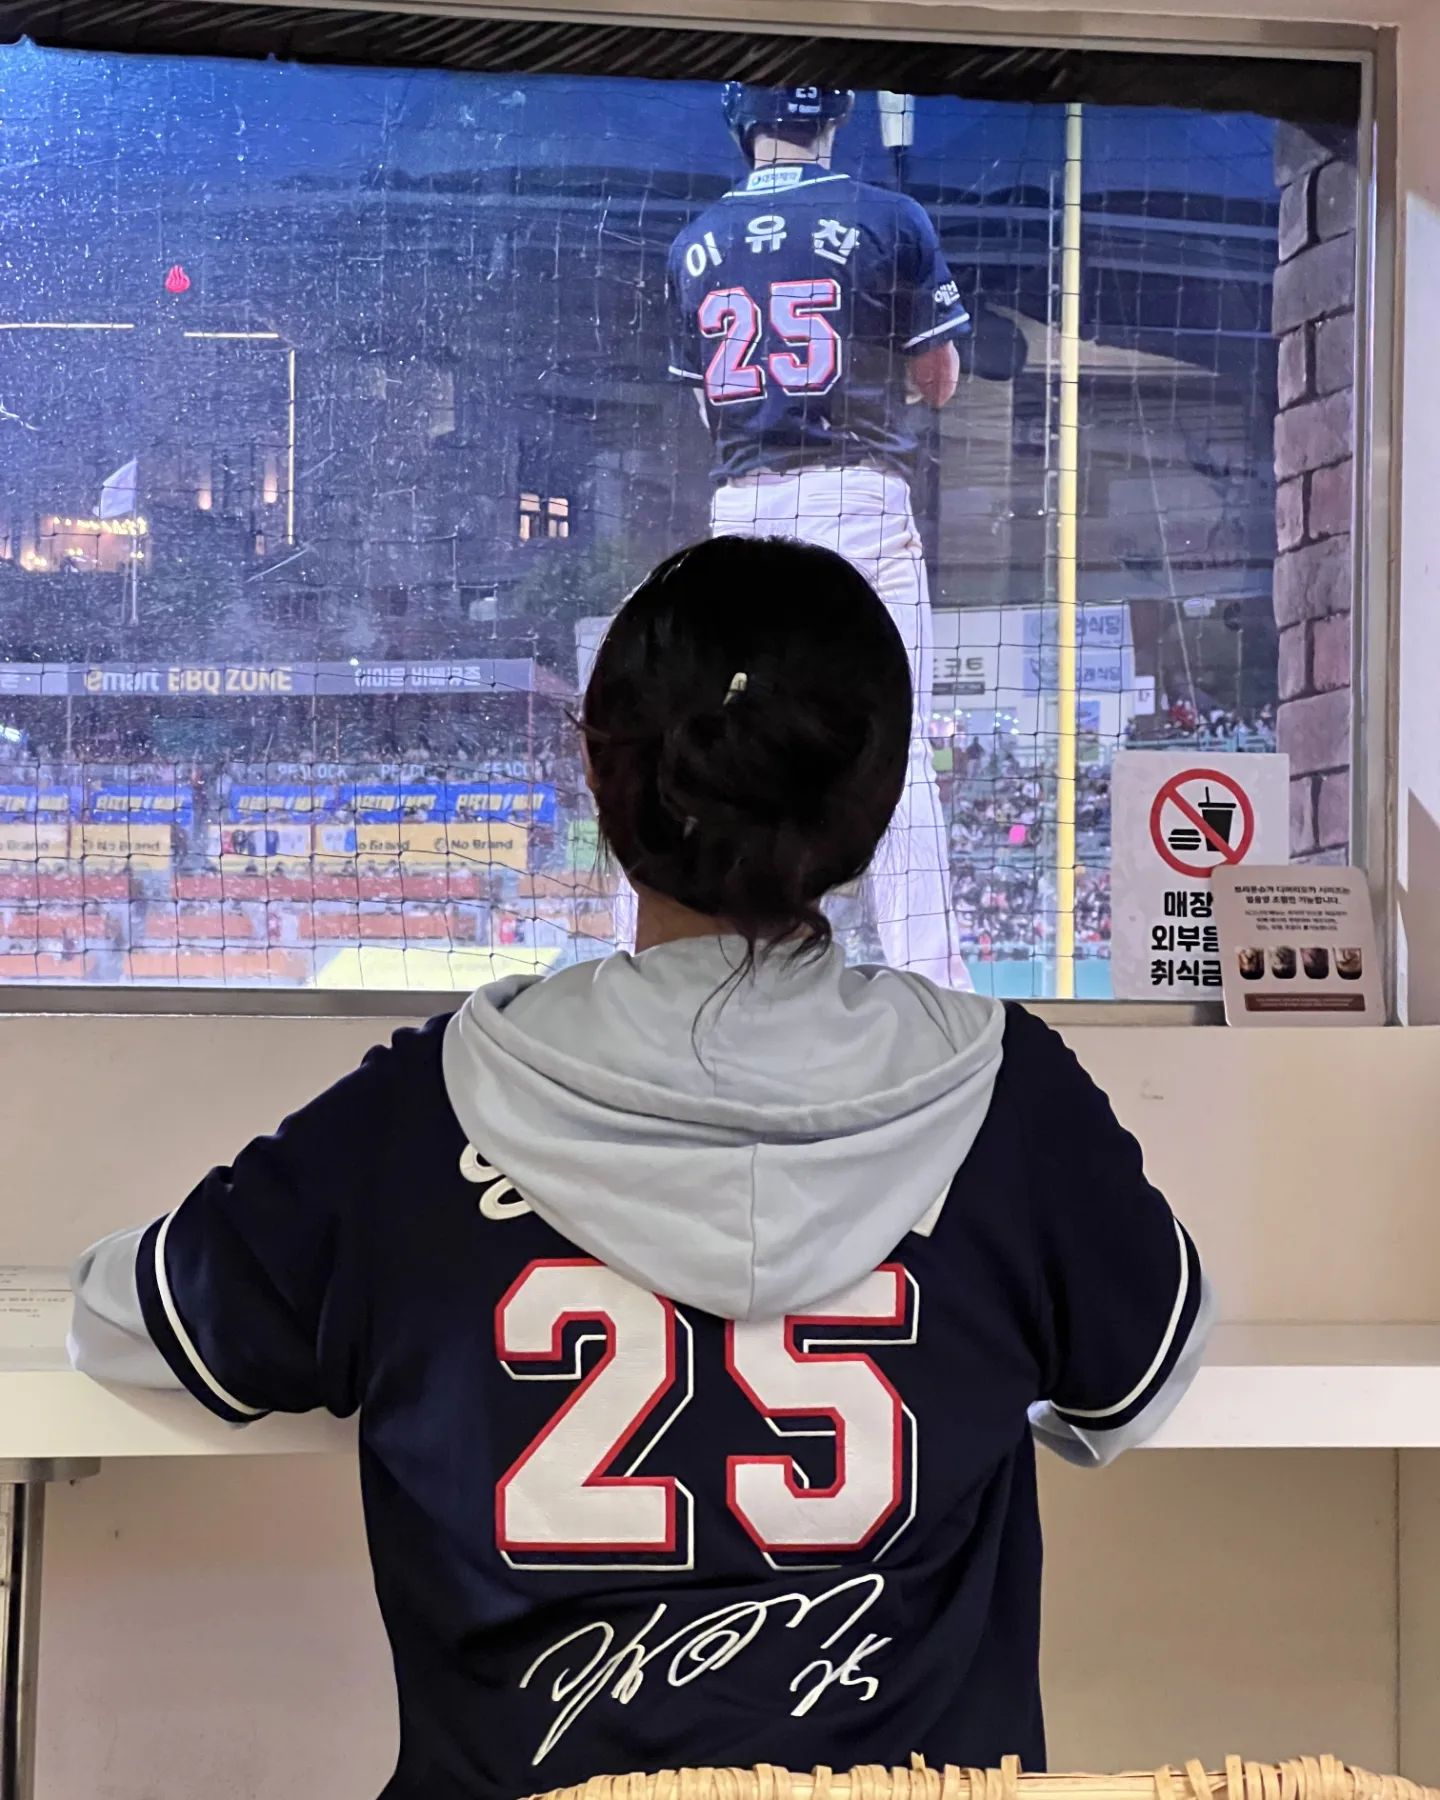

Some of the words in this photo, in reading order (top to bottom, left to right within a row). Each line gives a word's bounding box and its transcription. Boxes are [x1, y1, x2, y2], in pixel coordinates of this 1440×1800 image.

[697, 278, 843, 407] 25
[84, 667, 161, 692] emart
[167, 667, 220, 694] BBQ
[225, 666, 293, 691] ZONE
[451, 839, 469, 850] No
[473, 838, 513, 850] Brand
[494, 1257, 919, 1571] 25
